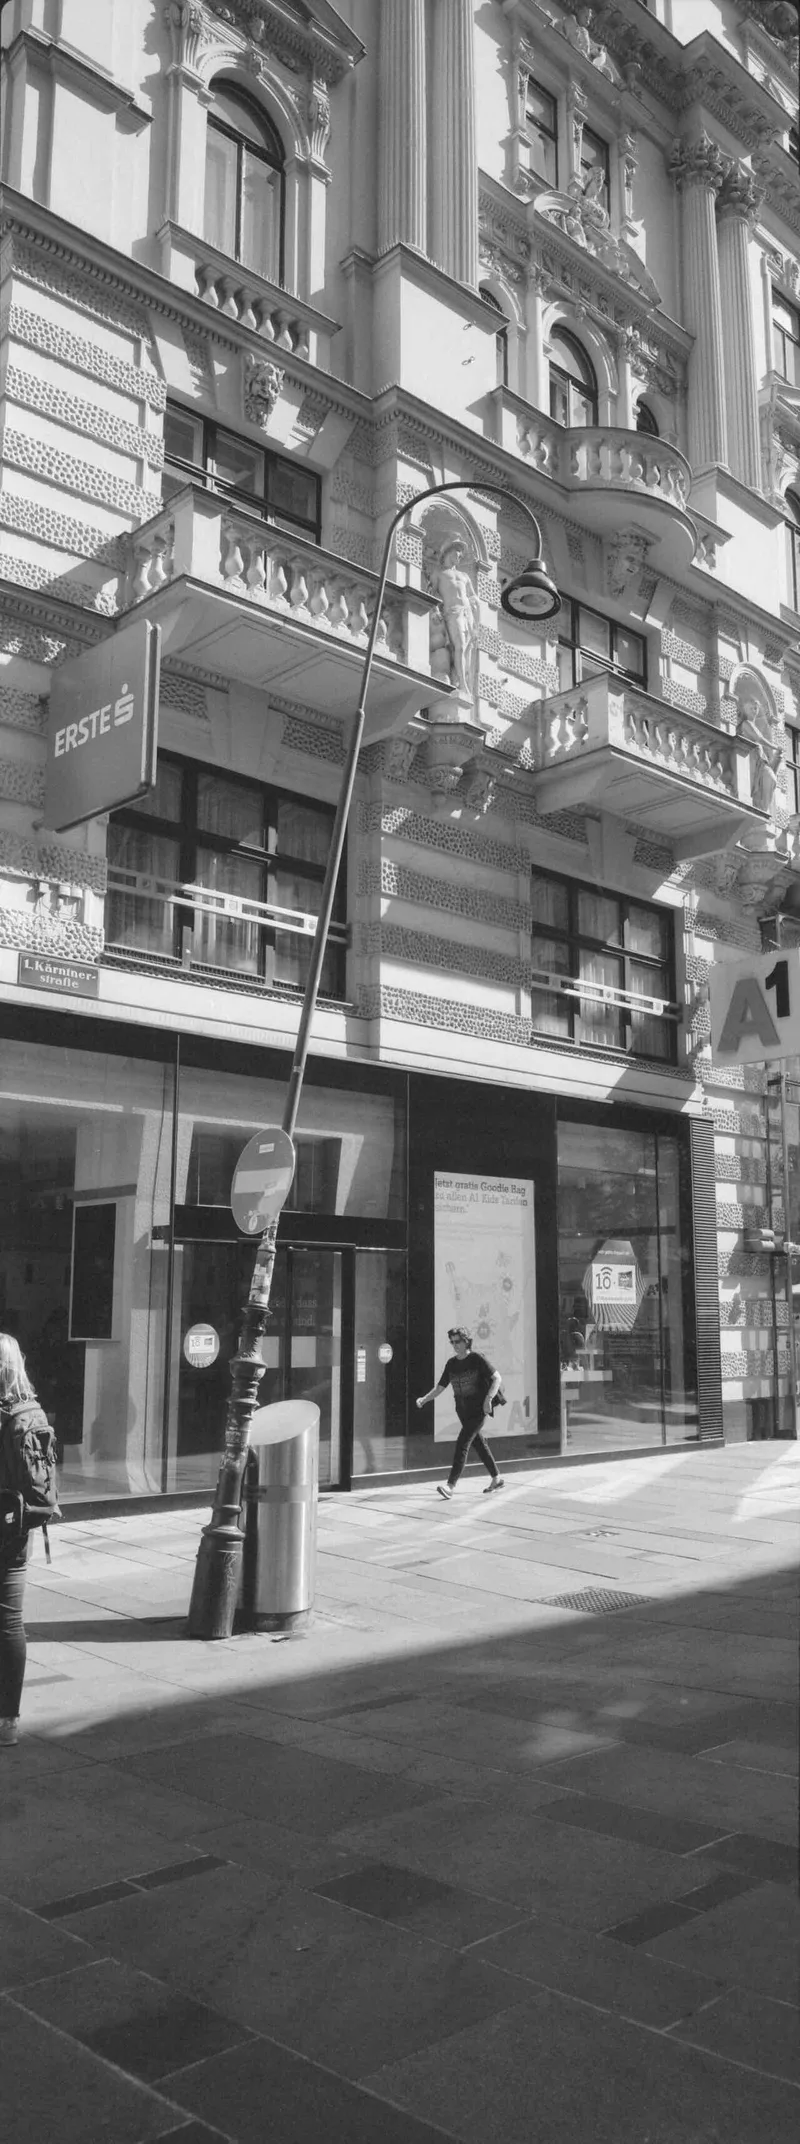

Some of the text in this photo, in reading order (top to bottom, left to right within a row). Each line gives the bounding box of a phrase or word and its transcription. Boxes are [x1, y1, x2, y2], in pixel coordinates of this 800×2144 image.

[55, 704, 111, 758] ERSTE
[717, 960, 791, 1053] A1
[480, 1182, 509, 1194] Goodie
[511, 1185, 526, 1197] Bag
